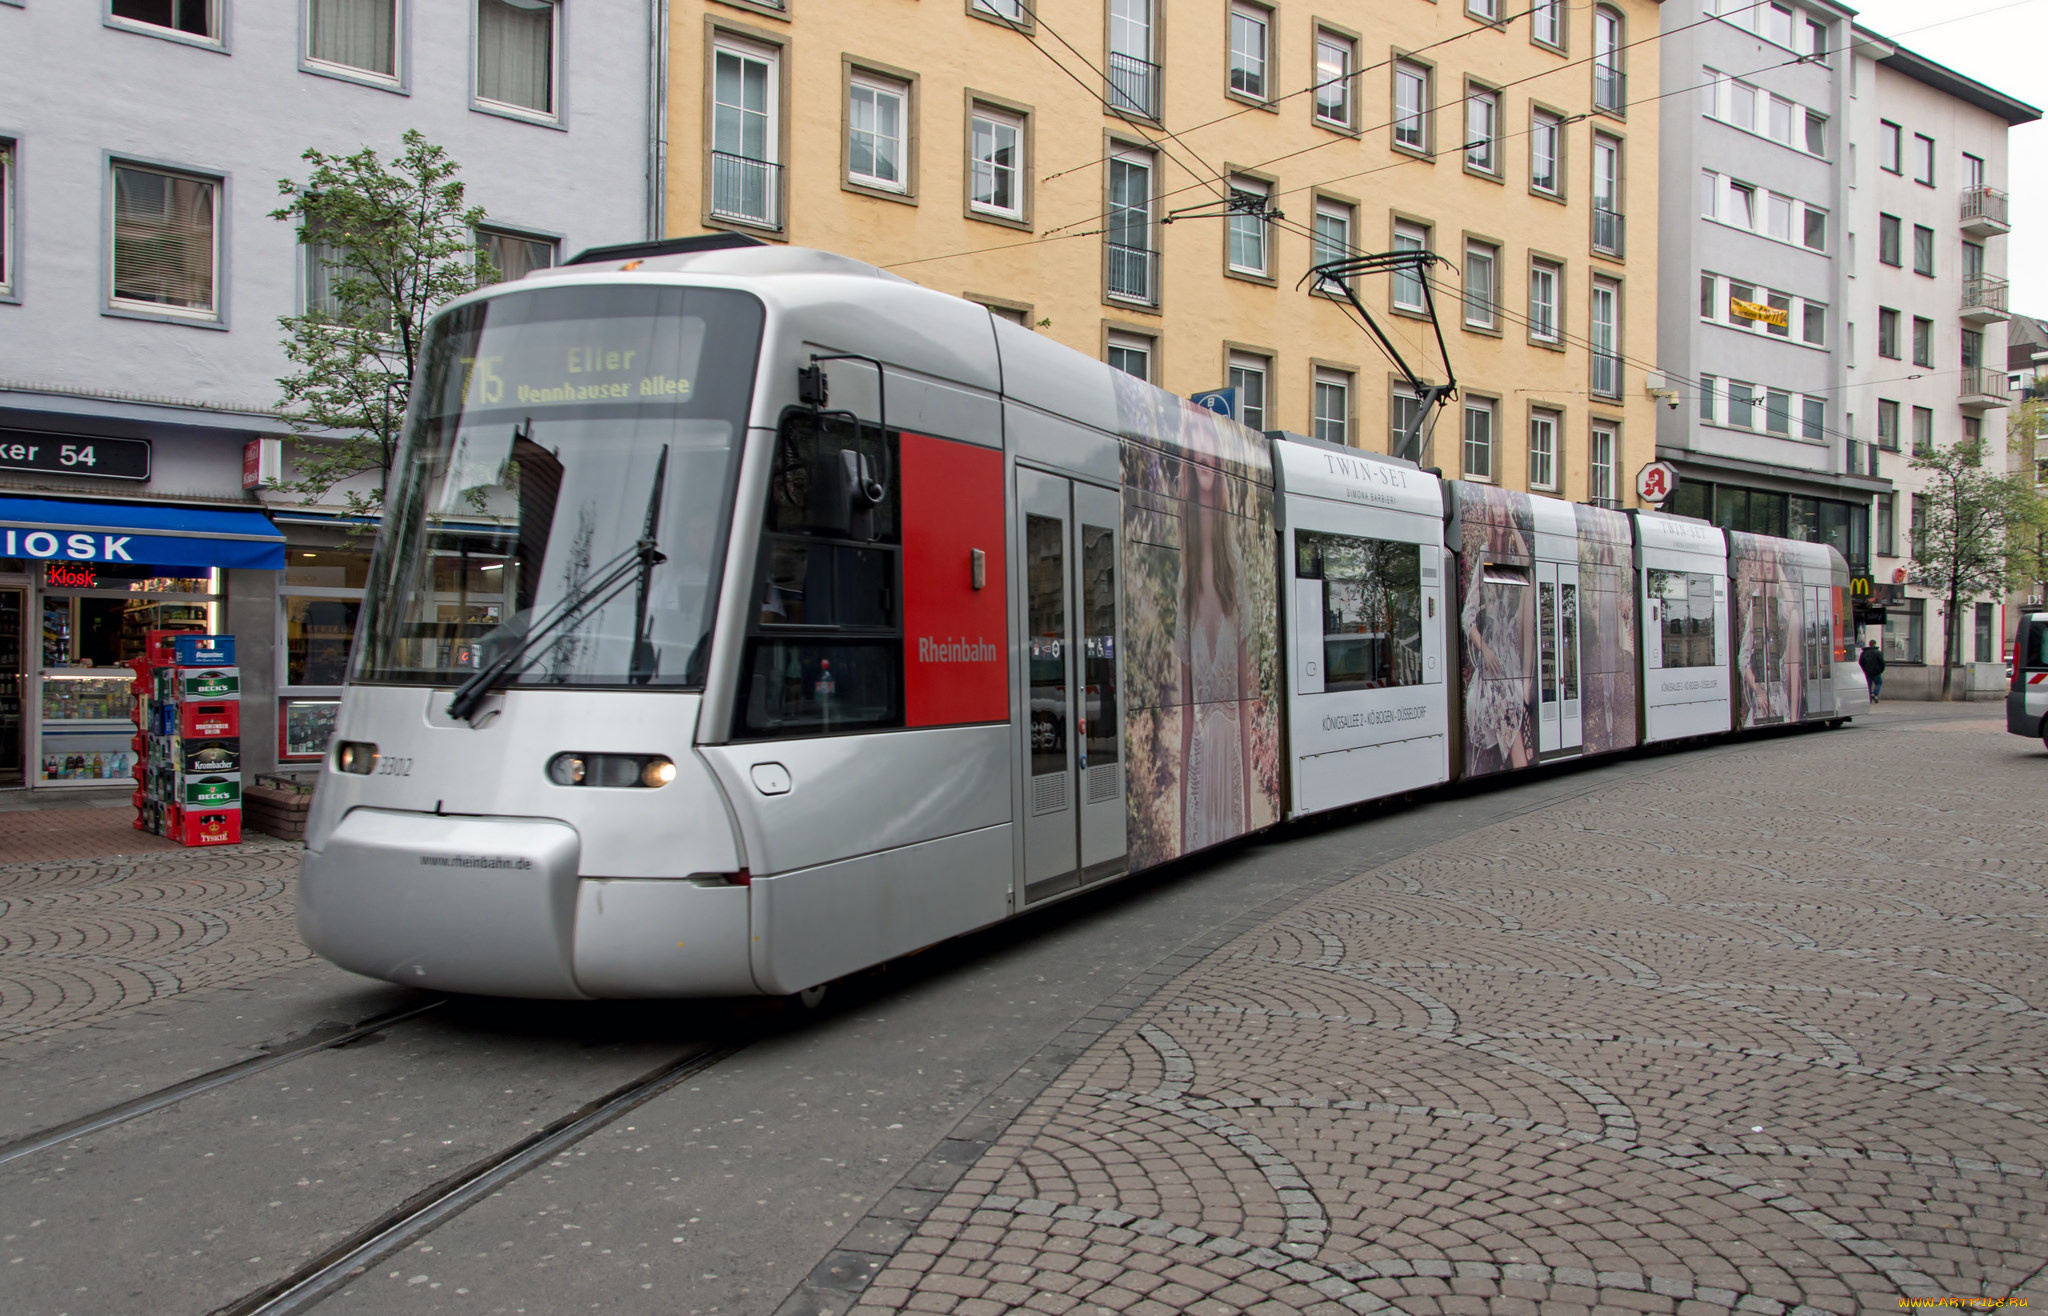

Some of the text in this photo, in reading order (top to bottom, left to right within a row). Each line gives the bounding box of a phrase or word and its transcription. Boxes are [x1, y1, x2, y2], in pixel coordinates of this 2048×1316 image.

[567, 347, 636, 373] Eller
[460, 355, 504, 404] 715
[517, 375, 691, 403] Vennhauser Allee
[60, 444, 97, 467] 54
[1323, 454, 1407, 489] TWIN-SET
[1345, 488, 1369, 500] SIMONA
[0, 530, 133, 561] IOSK
[918, 636, 997, 662] Rheinbahn
[198, 684, 229, 692] BECK'S
[1322, 713, 1359, 731] KÖNIGSALLEE
[1376, 709, 1395, 725] BOGEN
[1397, 706, 1427, 722] DÜSSELDORF
[195, 760, 233, 770] Krombacher
[198, 792, 230, 801] BECK'S
[200, 833, 228, 843] TYSKIE
[420, 854, 533, 871] www.rheinbahn.de
